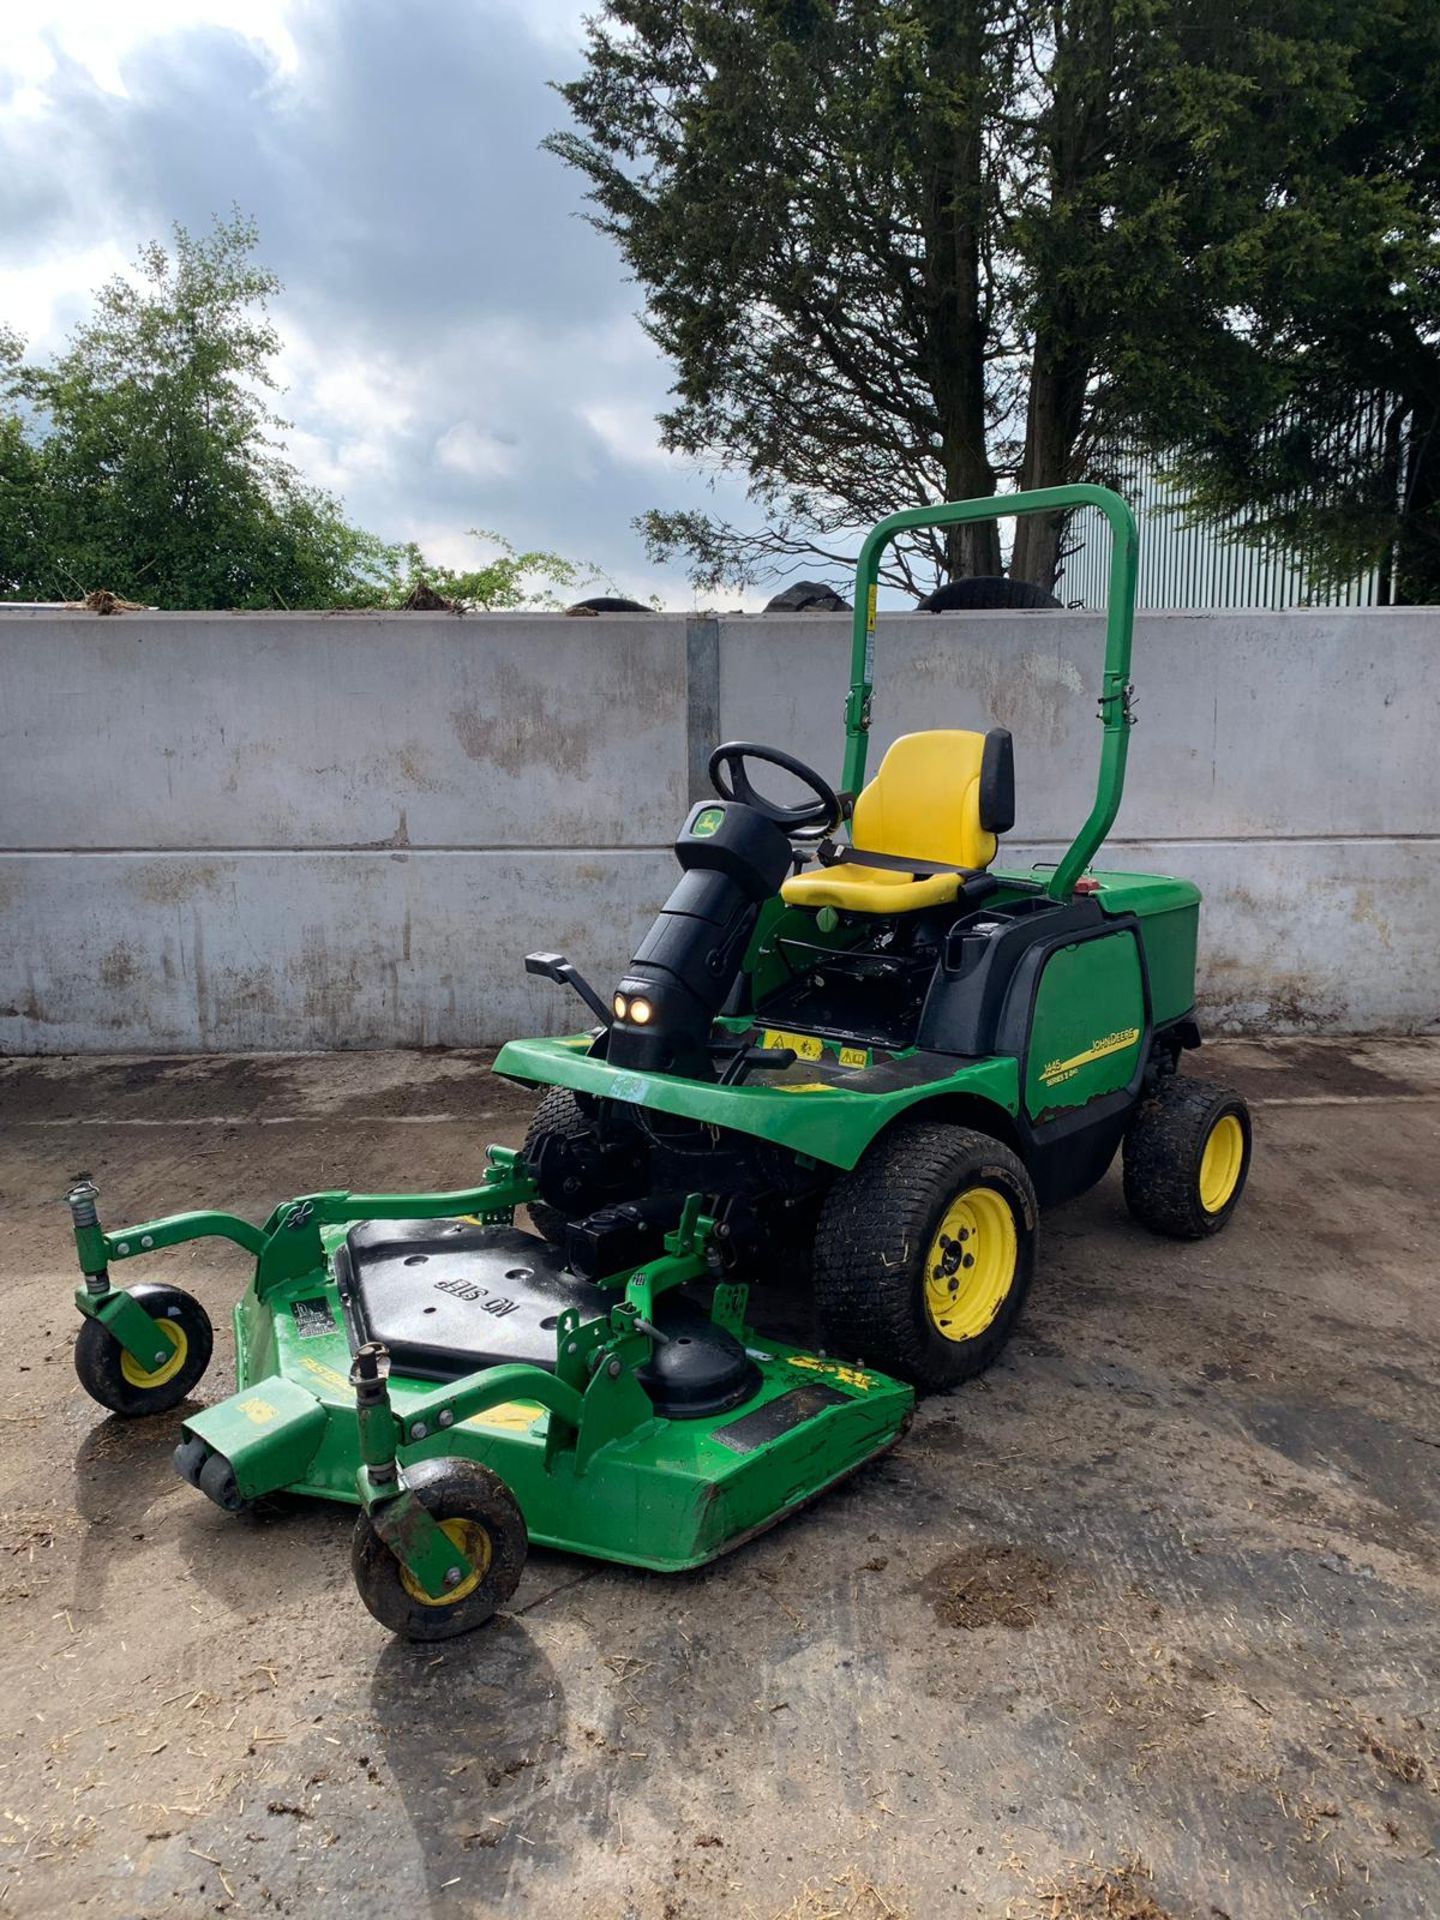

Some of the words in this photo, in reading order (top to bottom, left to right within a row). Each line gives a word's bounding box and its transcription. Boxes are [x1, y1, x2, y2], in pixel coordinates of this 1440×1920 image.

[1091, 1038, 1110, 1052] JOHN
[1110, 1028, 1134, 1043] DEERE
[434, 1279, 489, 1301] STEP
[480, 1297, 520, 1318] NO
